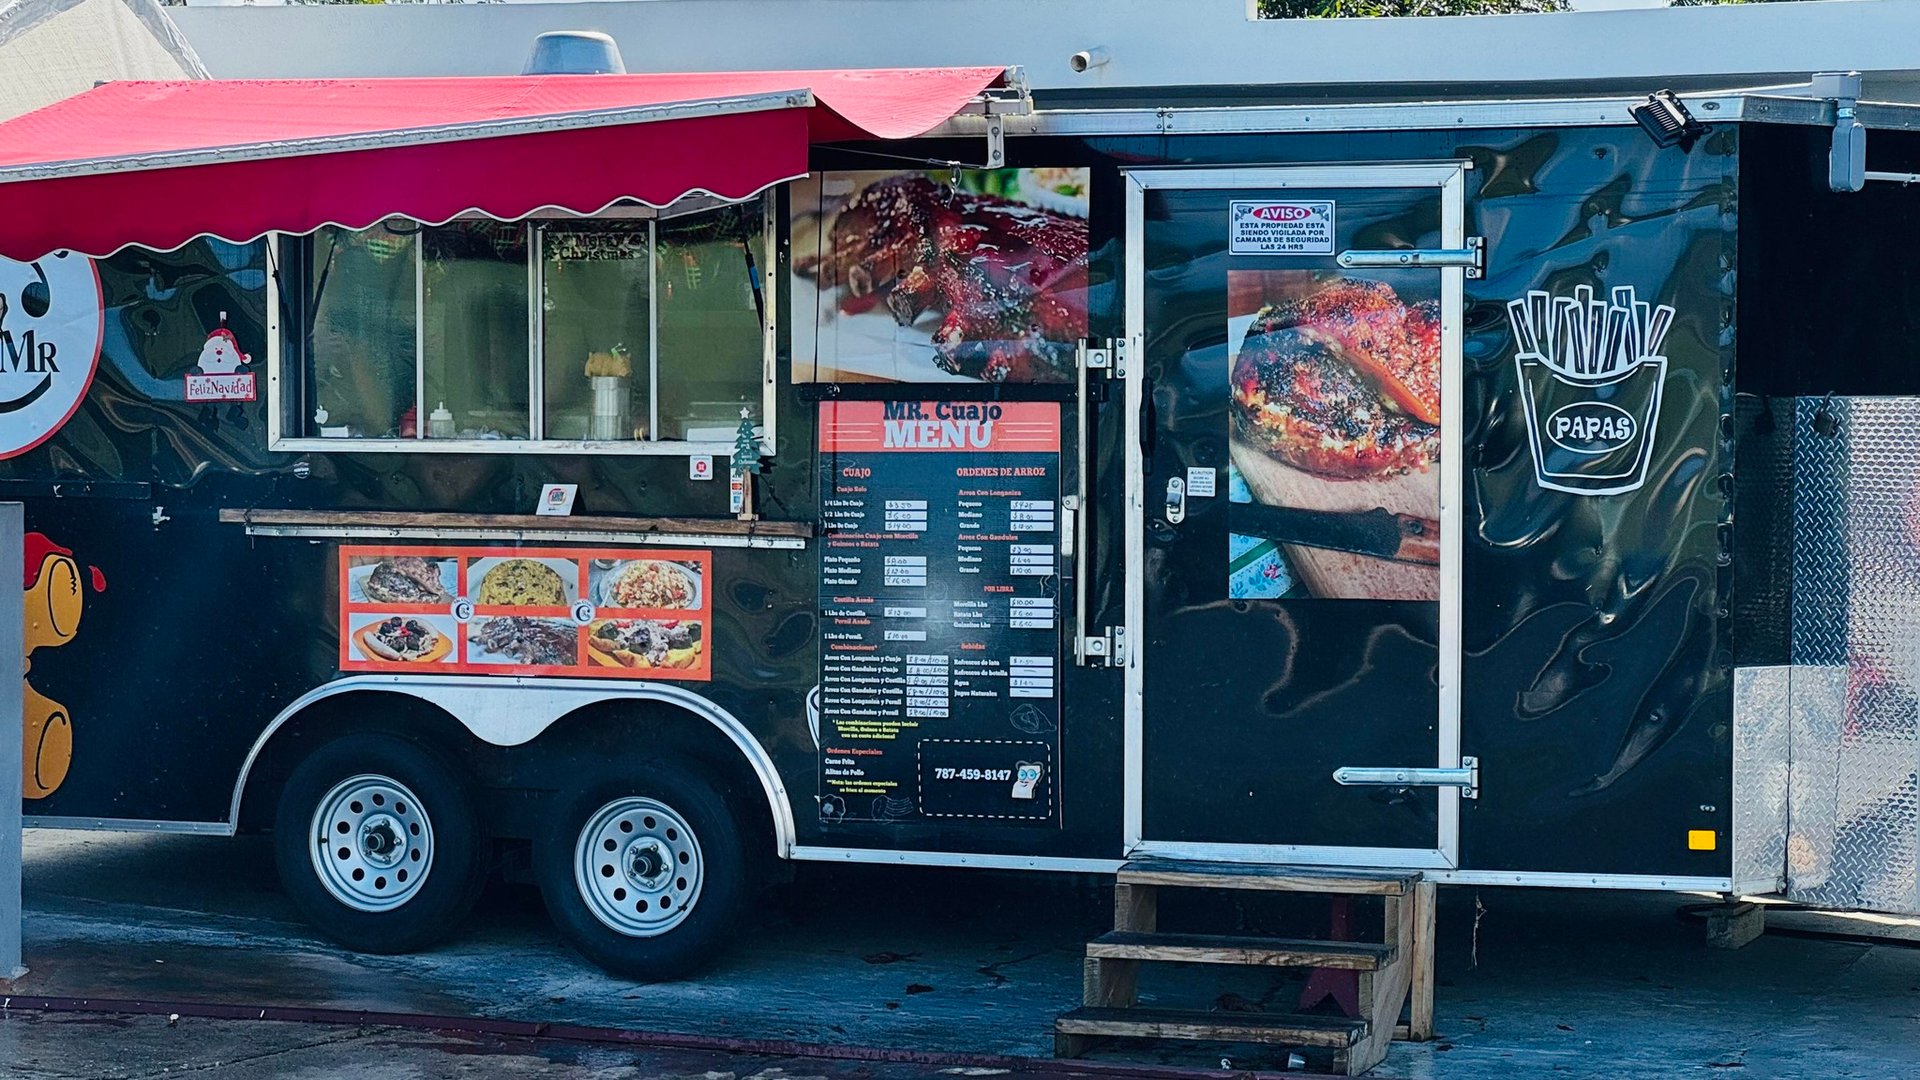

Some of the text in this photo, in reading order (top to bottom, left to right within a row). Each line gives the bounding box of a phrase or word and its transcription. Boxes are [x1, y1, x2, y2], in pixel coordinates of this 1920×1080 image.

[1260, 208, 1305, 219] AVISO
[560, 247, 634, 260] Christmas
[211, 380, 252, 395] Navidad
[883, 401, 1002, 425] MR. Cuajo
[1555, 416, 1631, 440] PAPAS
[883, 420, 994, 449] MENU
[843, 468, 871, 478] CUAJO
[956, 467, 1046, 477] ORDENES DE ARROZ
[851, 748, 883, 756] Especiales
[935, 768, 1011, 780] 787-459-8147
